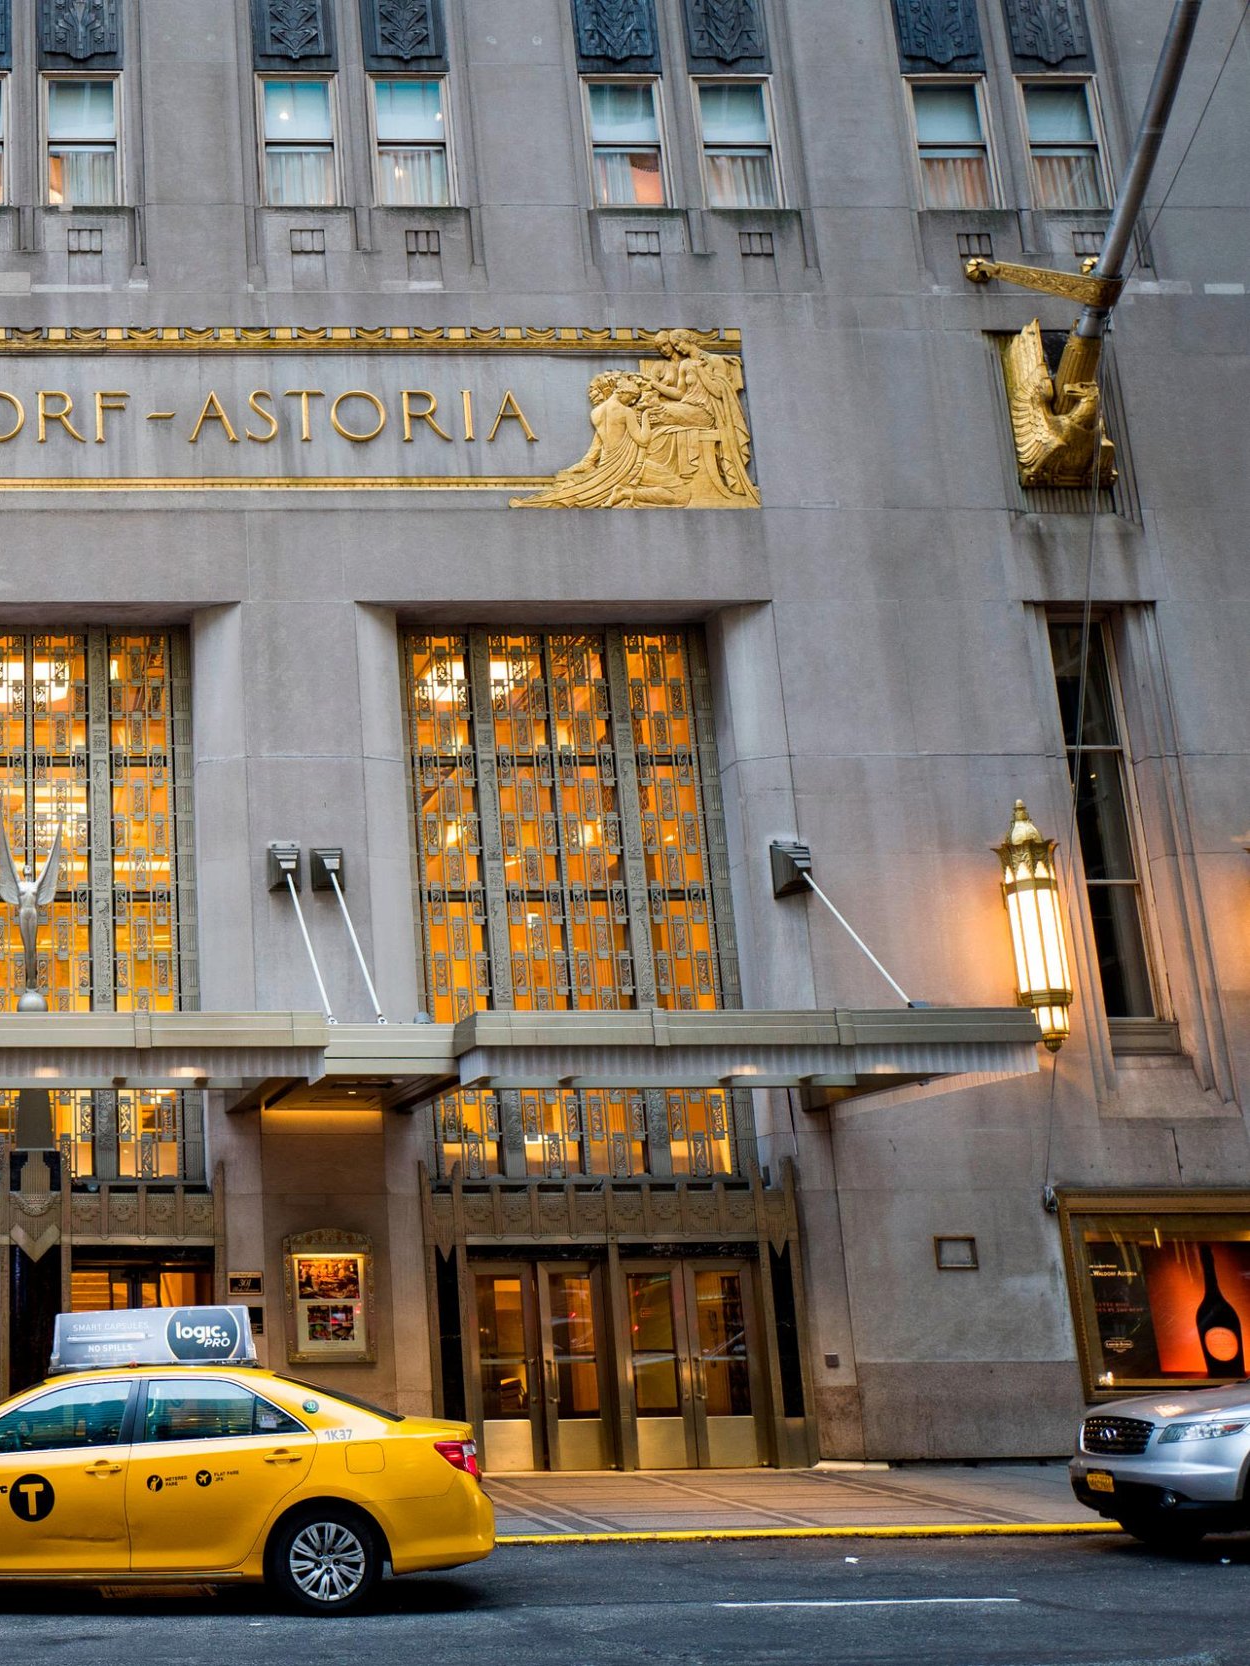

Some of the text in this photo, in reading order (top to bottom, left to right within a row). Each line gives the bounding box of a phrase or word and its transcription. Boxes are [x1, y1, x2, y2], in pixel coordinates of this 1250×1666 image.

[72, 1323, 102, 1332] SMART
[203, 1337, 231, 1348] PRO
[88, 1344, 100, 1353] NO
[324, 1429, 353, 1441] 1K37
[18, 1483, 44, 1516] T
